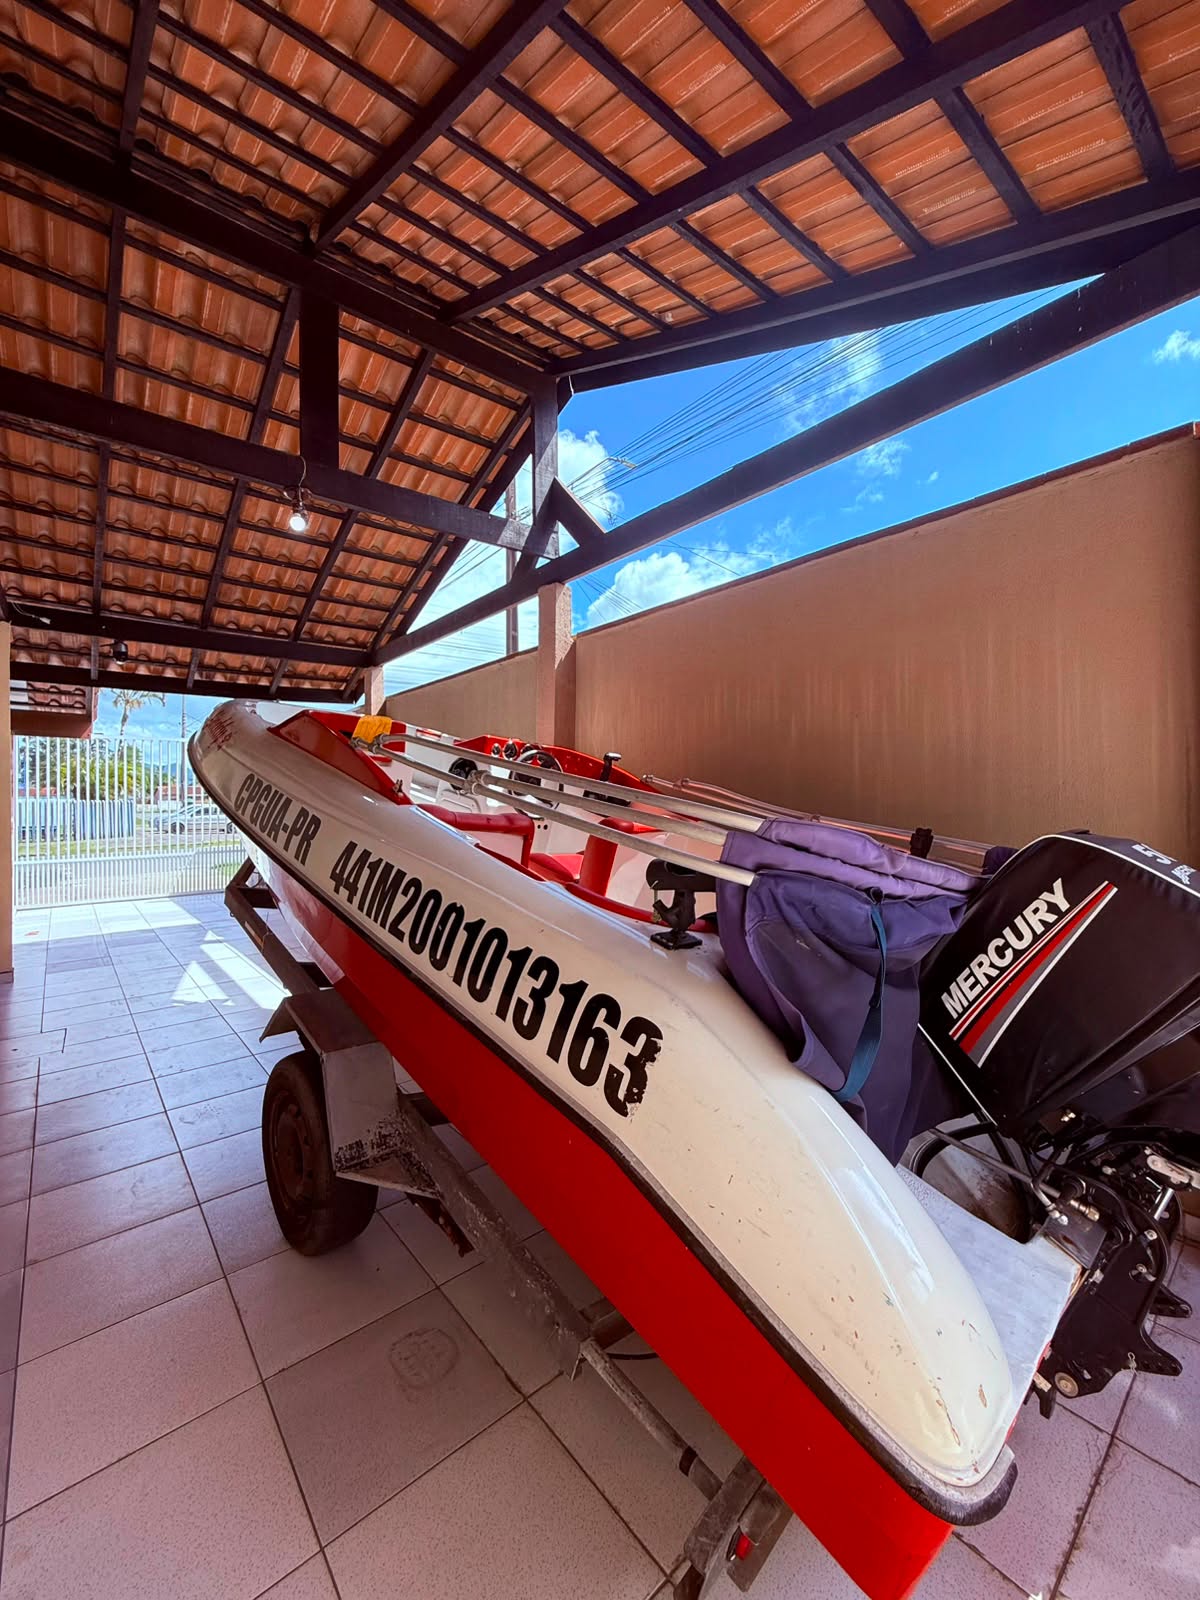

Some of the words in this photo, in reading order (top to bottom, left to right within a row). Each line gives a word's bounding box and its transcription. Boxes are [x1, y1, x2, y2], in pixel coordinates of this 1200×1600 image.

[234, 773, 322, 866] CPGUA-PR
[329, 840, 664, 1118] 441M2001013163
[940, 877, 1071, 1020] MERCURY
